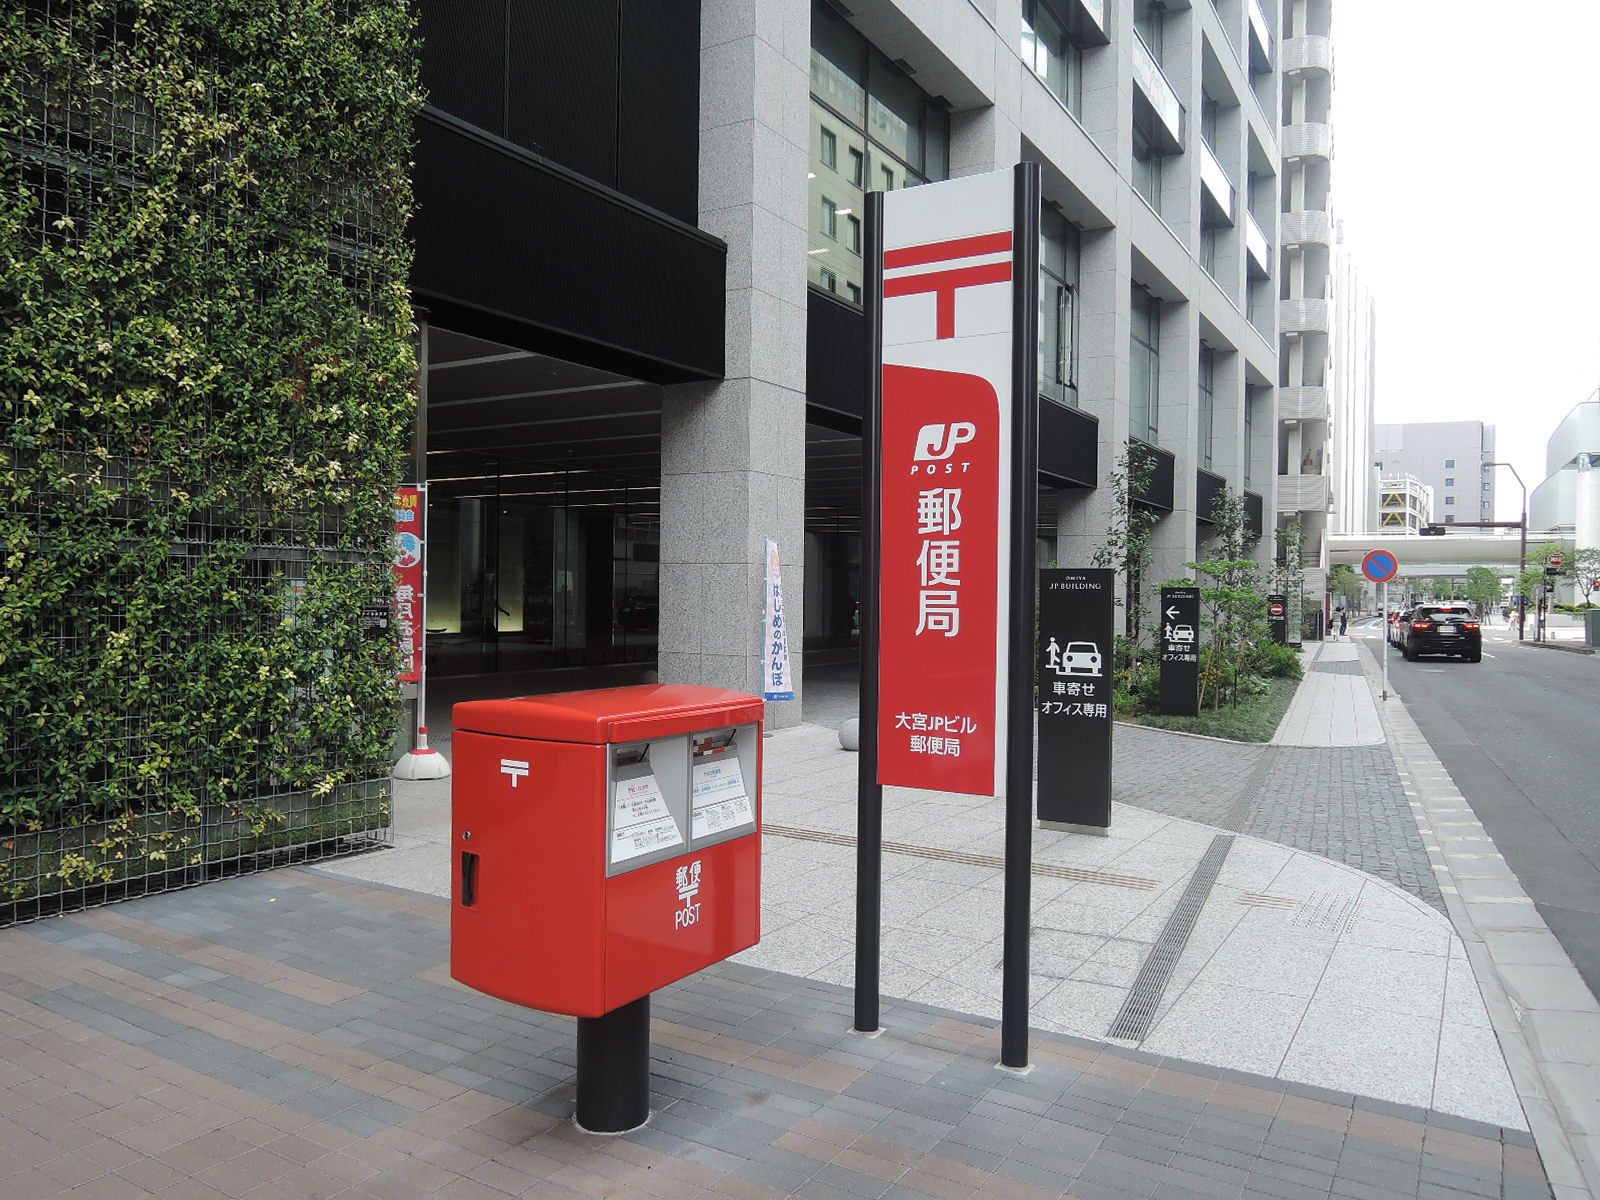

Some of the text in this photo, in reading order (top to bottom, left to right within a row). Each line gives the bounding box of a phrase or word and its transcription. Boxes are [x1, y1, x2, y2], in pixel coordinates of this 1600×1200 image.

[914, 422, 976, 461] JP
[910, 462, 970, 475] POST
[915, 487, 962, 637] 郵便局
[1049, 582, 1102, 590] JP BUILDING
[771, 582, 783, 687] はじめのかんぽ
[1052, 681, 1096, 697] 車寄せ
[1041, 700, 1107, 718] オフィス専用
[895, 711, 977, 734] 大宮JPビル
[910, 735, 960, 757] 郵便局
[675, 860, 702, 890] 郵便
[675, 902, 701, 930] POST
